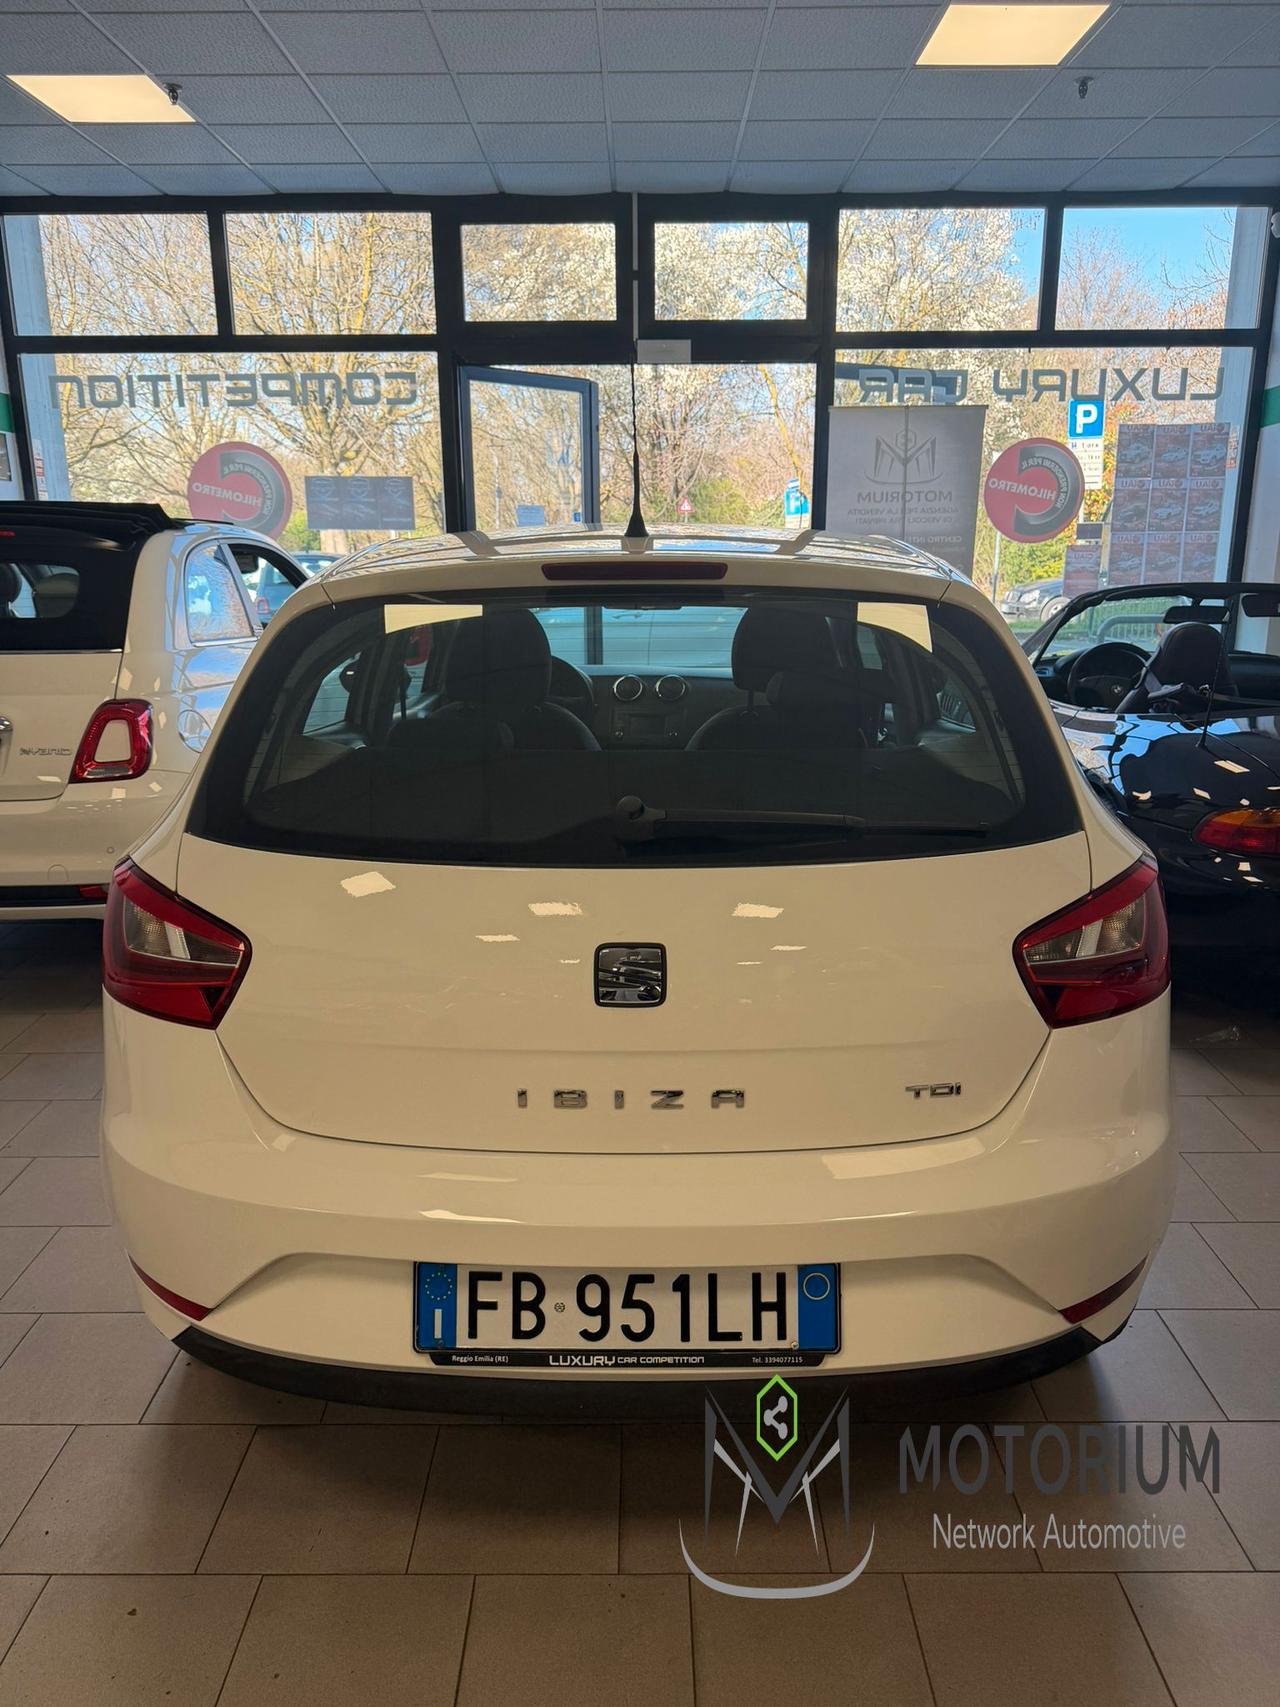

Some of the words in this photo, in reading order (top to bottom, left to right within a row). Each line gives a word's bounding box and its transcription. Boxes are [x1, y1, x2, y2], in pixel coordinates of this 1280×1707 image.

[1075, 403, 1098, 434] P
[517, 1088, 746, 1110] IBIZA
[467, 1271, 546, 1340] FB
[575, 1272, 788, 1343] 951LH
[549, 1355, 615, 1366] LUXURY
[617, 1356, 637, 1364] CAR
[640, 1356, 705, 1364] COMPETITION
